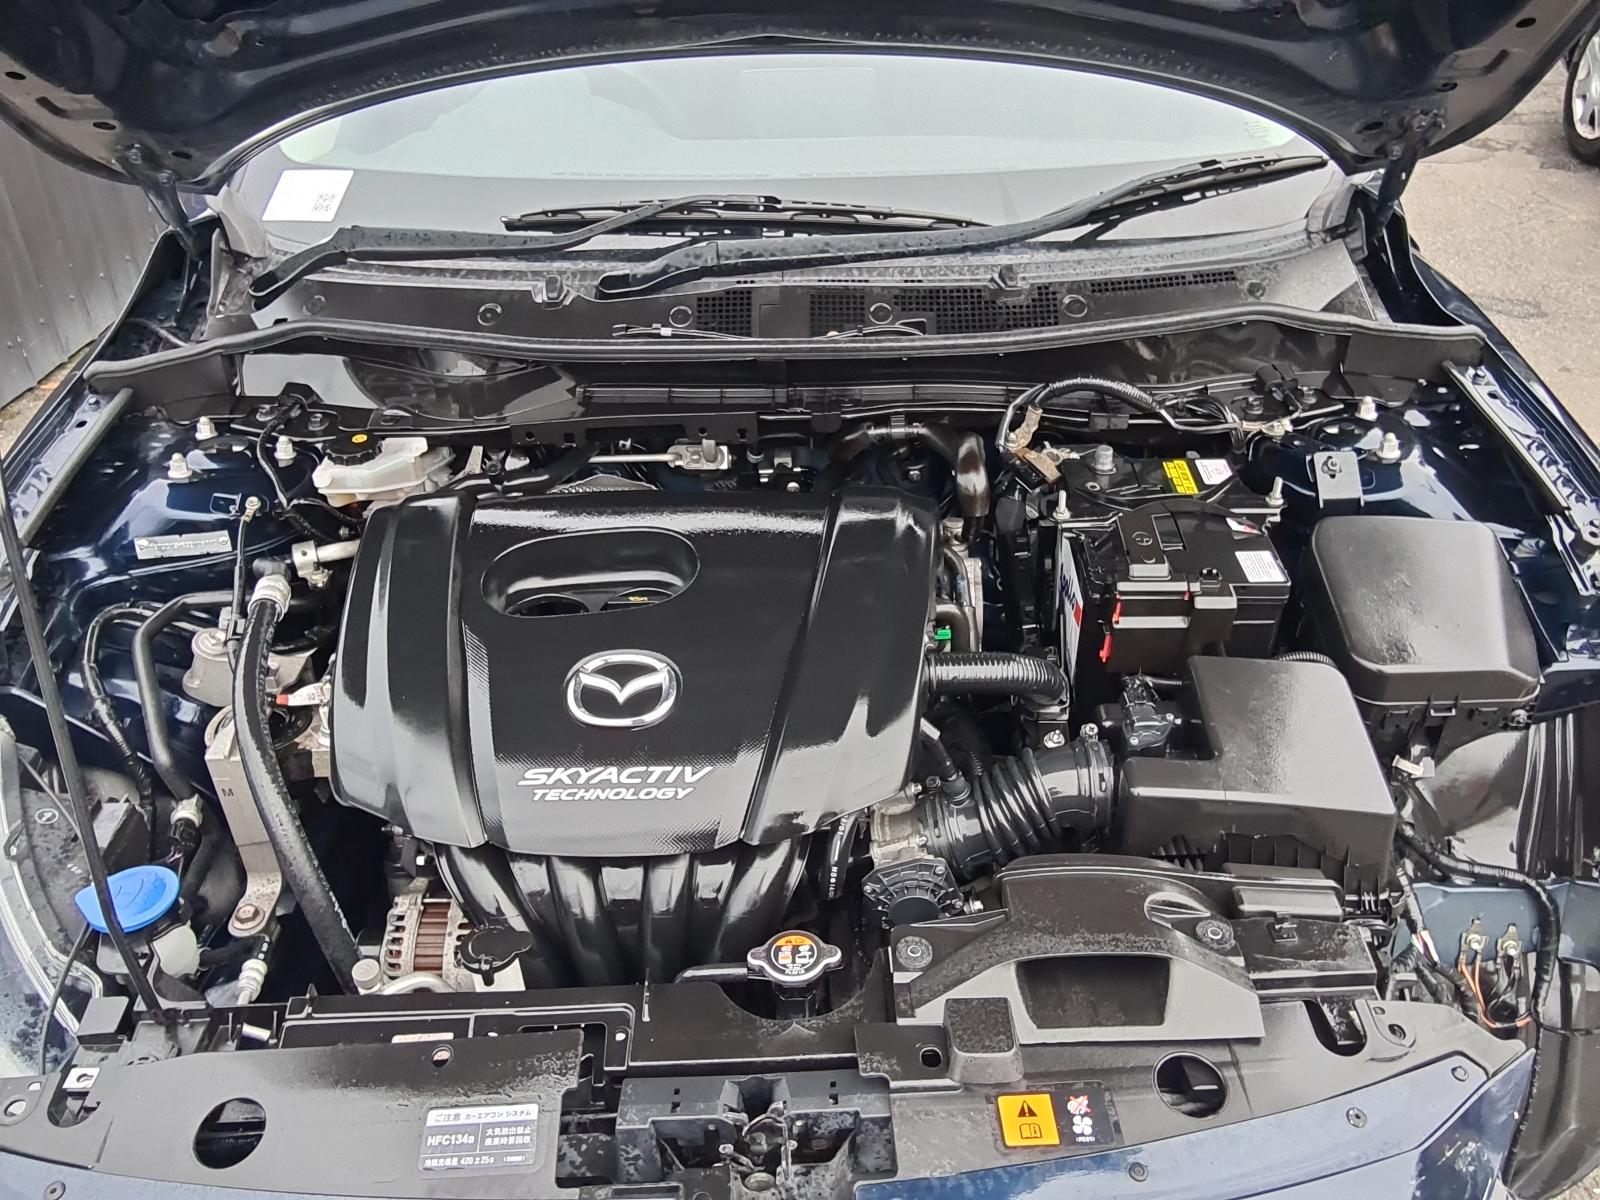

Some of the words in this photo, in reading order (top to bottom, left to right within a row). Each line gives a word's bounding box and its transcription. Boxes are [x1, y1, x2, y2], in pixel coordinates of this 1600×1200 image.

[518, 766, 713, 786] SKYACTIV
[221, 787, 235, 797] M
[533, 787, 694, 801] TECHNOLOGY
[427, 1134, 475, 1146] HFC134a
